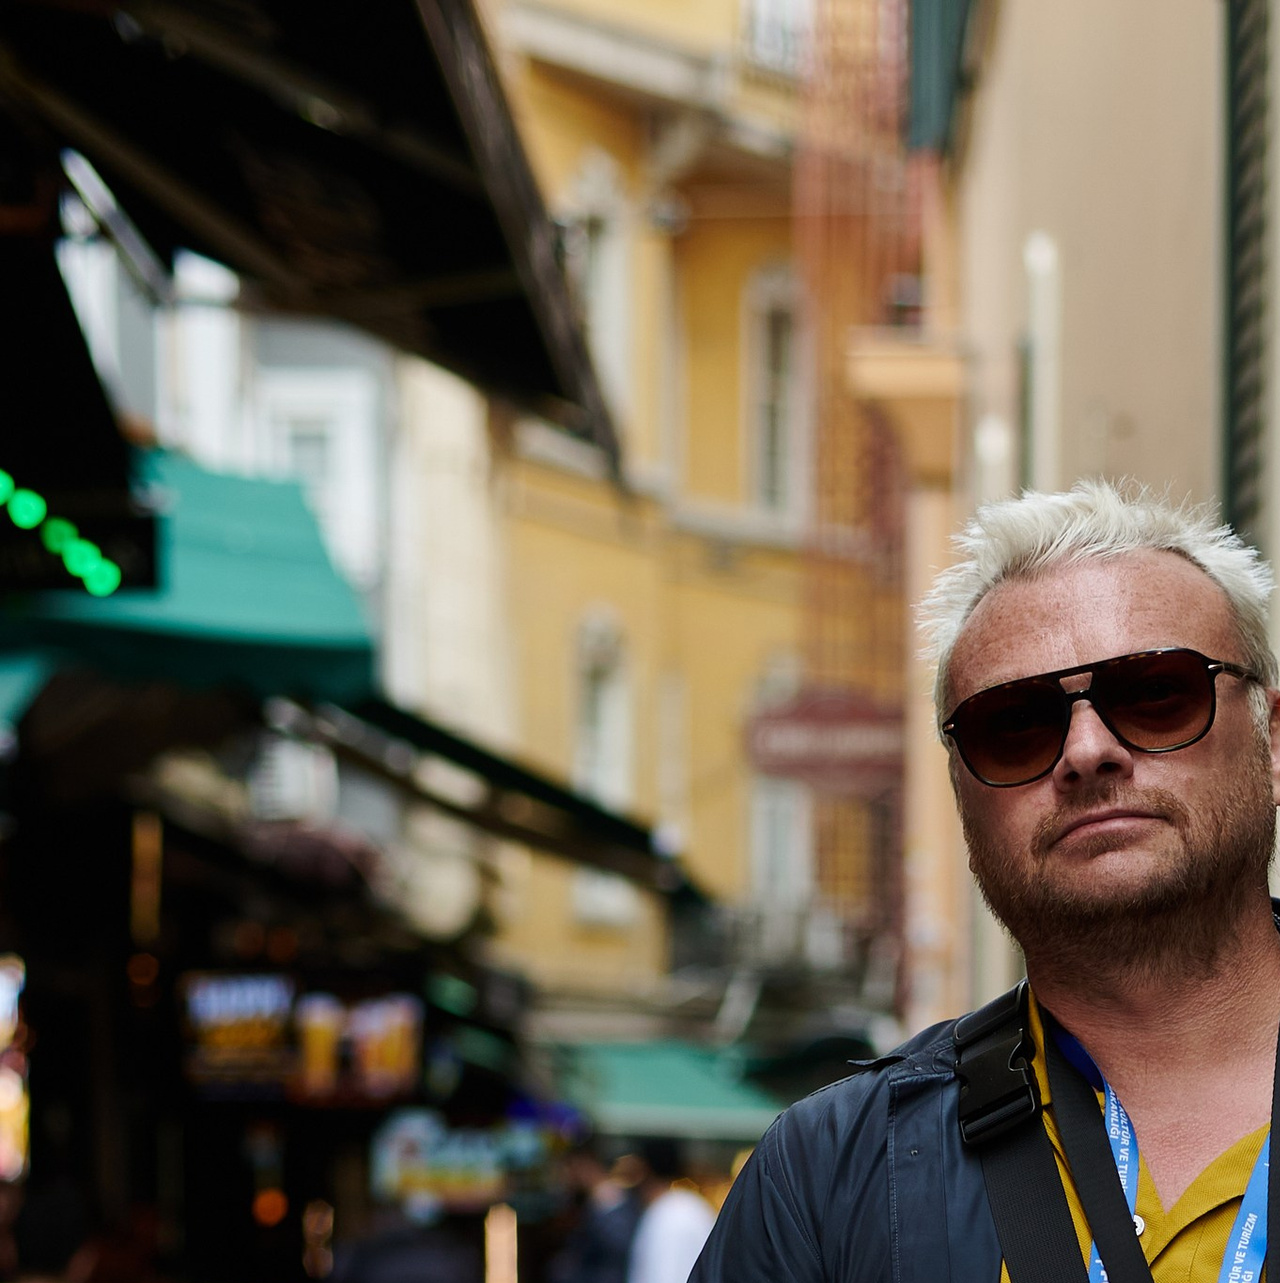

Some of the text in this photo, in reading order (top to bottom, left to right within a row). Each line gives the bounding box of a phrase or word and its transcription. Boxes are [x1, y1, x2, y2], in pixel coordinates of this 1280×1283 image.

[1107, 1083, 1119, 1140] AKANLIĞI
[1119, 1147, 1129, 1162] VE
[1237, 1212, 1258, 1250] TURİZM
[1233, 1249, 1247, 1265] VE
